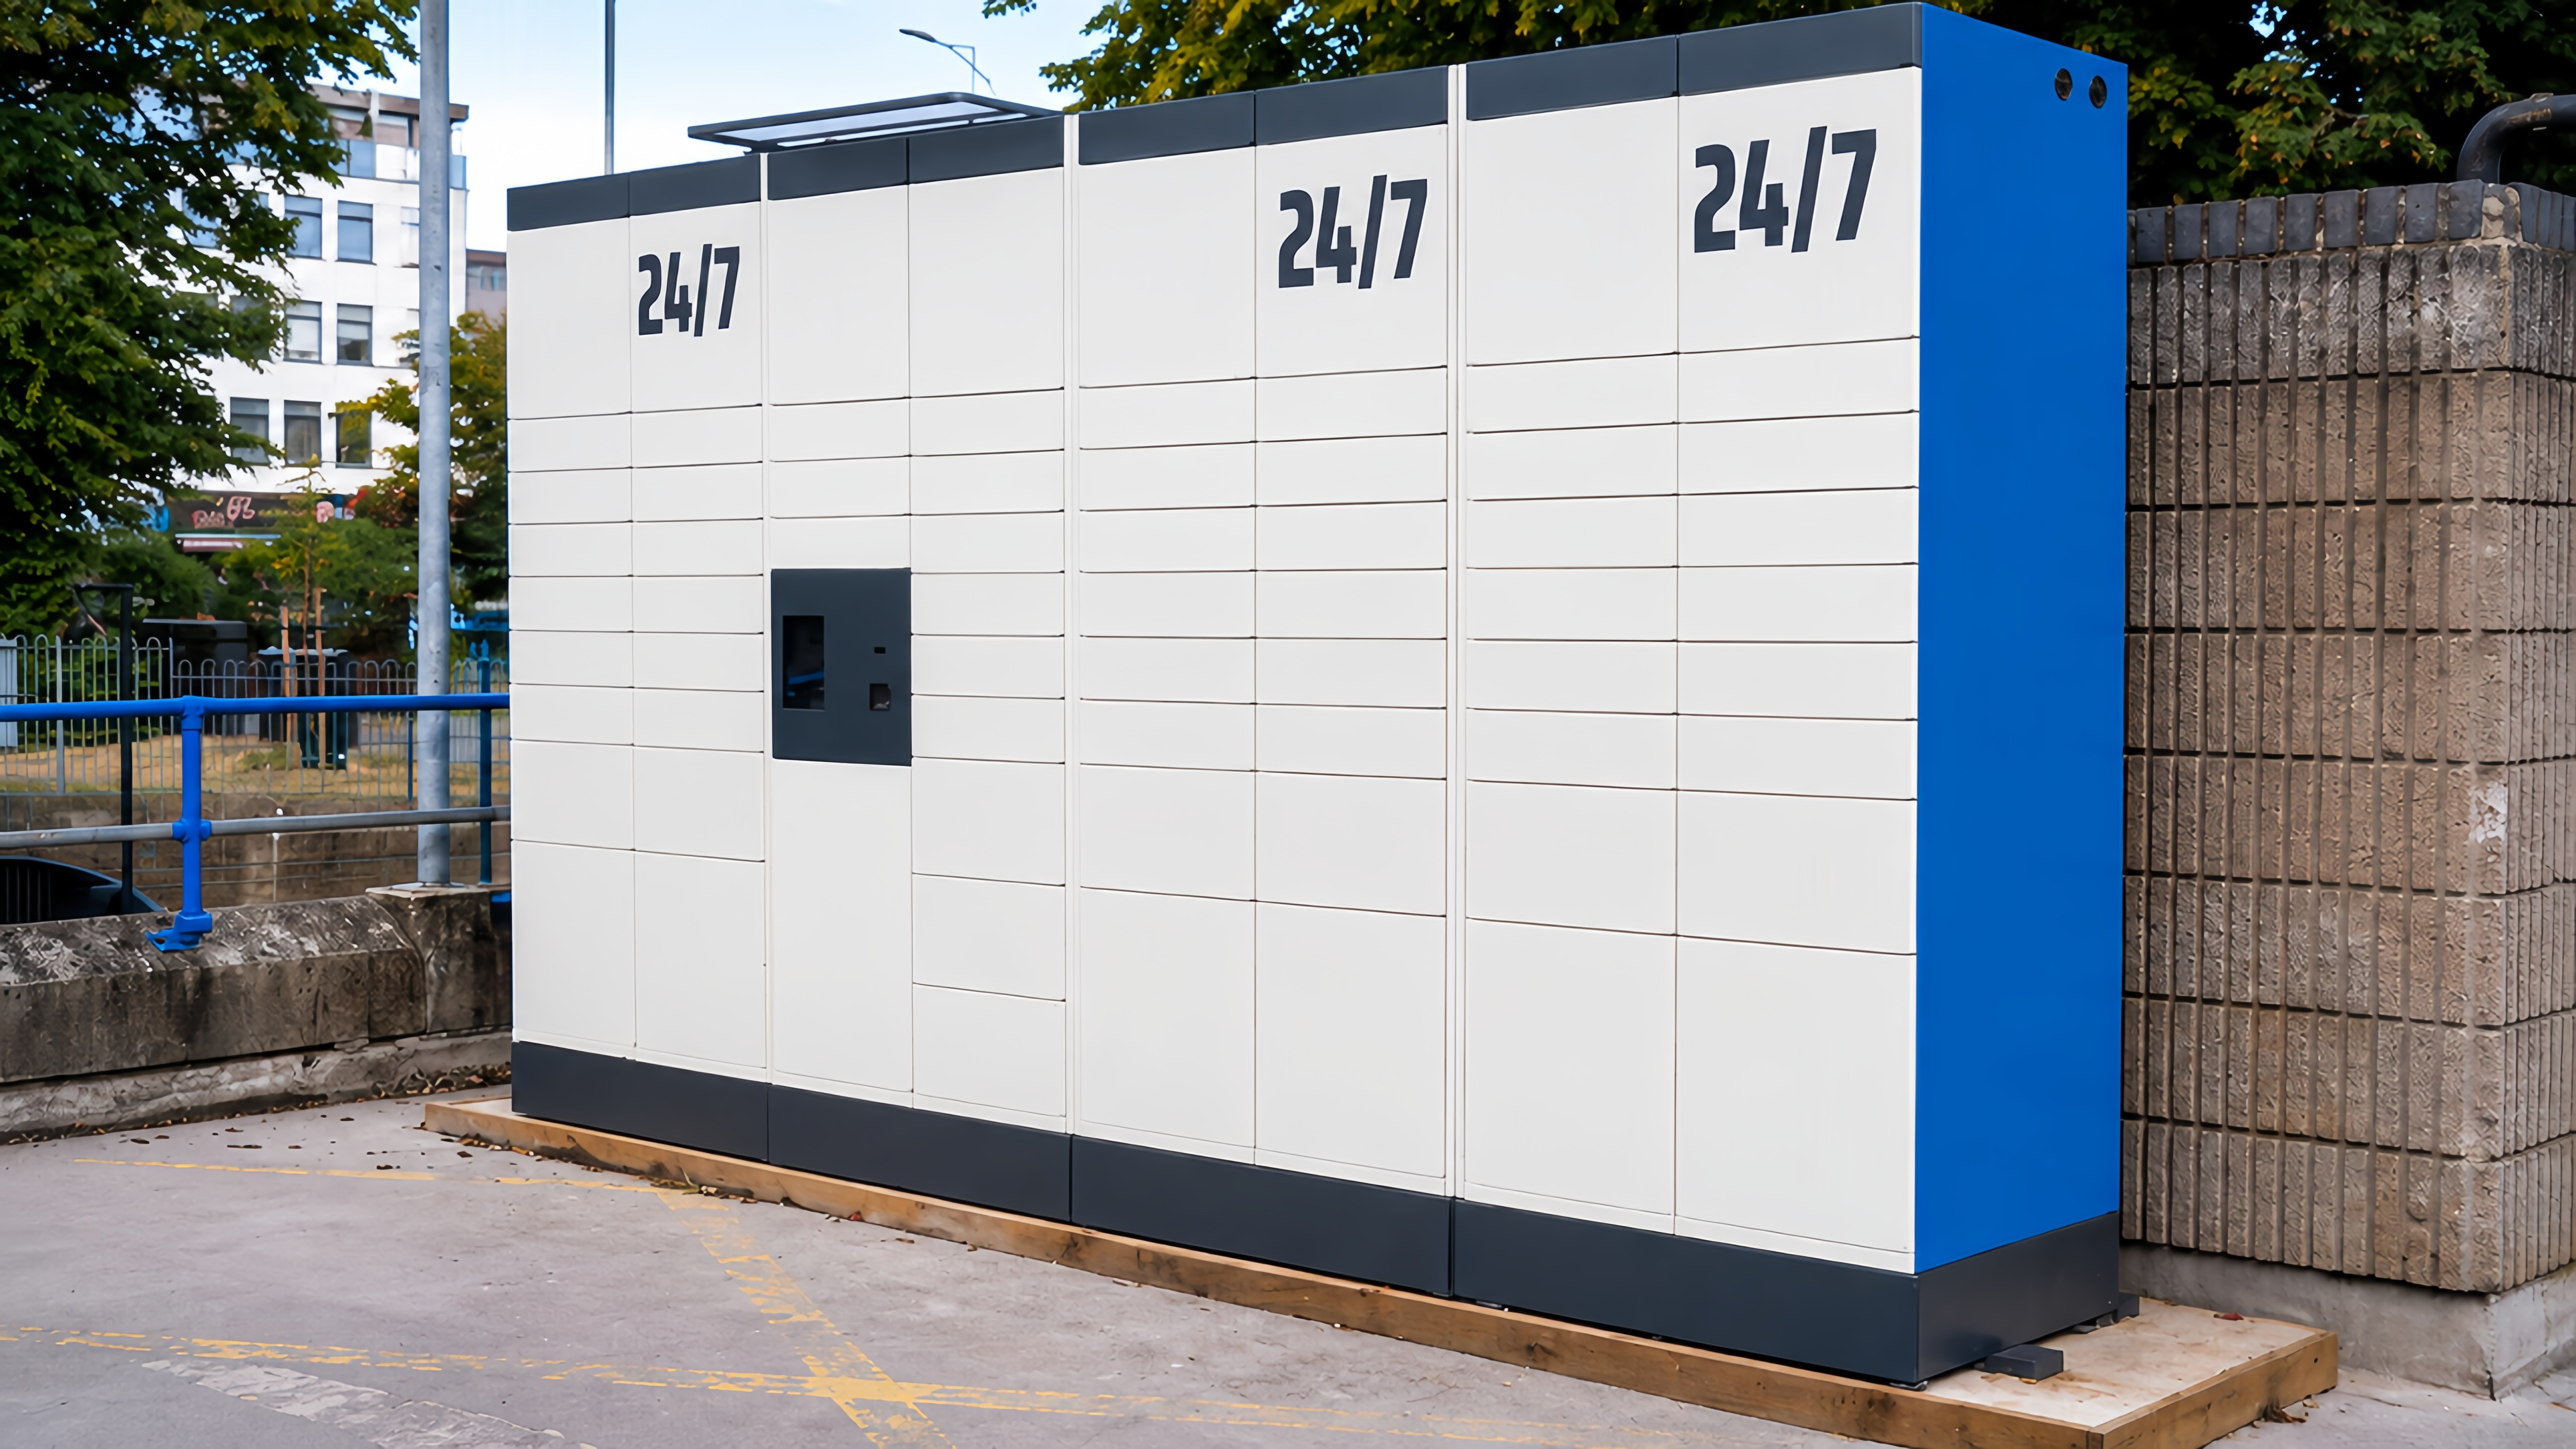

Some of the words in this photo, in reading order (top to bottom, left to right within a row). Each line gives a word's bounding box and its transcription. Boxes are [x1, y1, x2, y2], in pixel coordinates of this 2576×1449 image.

[1278, 174, 1427, 289] 24/7
[1694, 126, 1878, 253] 24/7
[638, 244, 740, 337] 24/7
